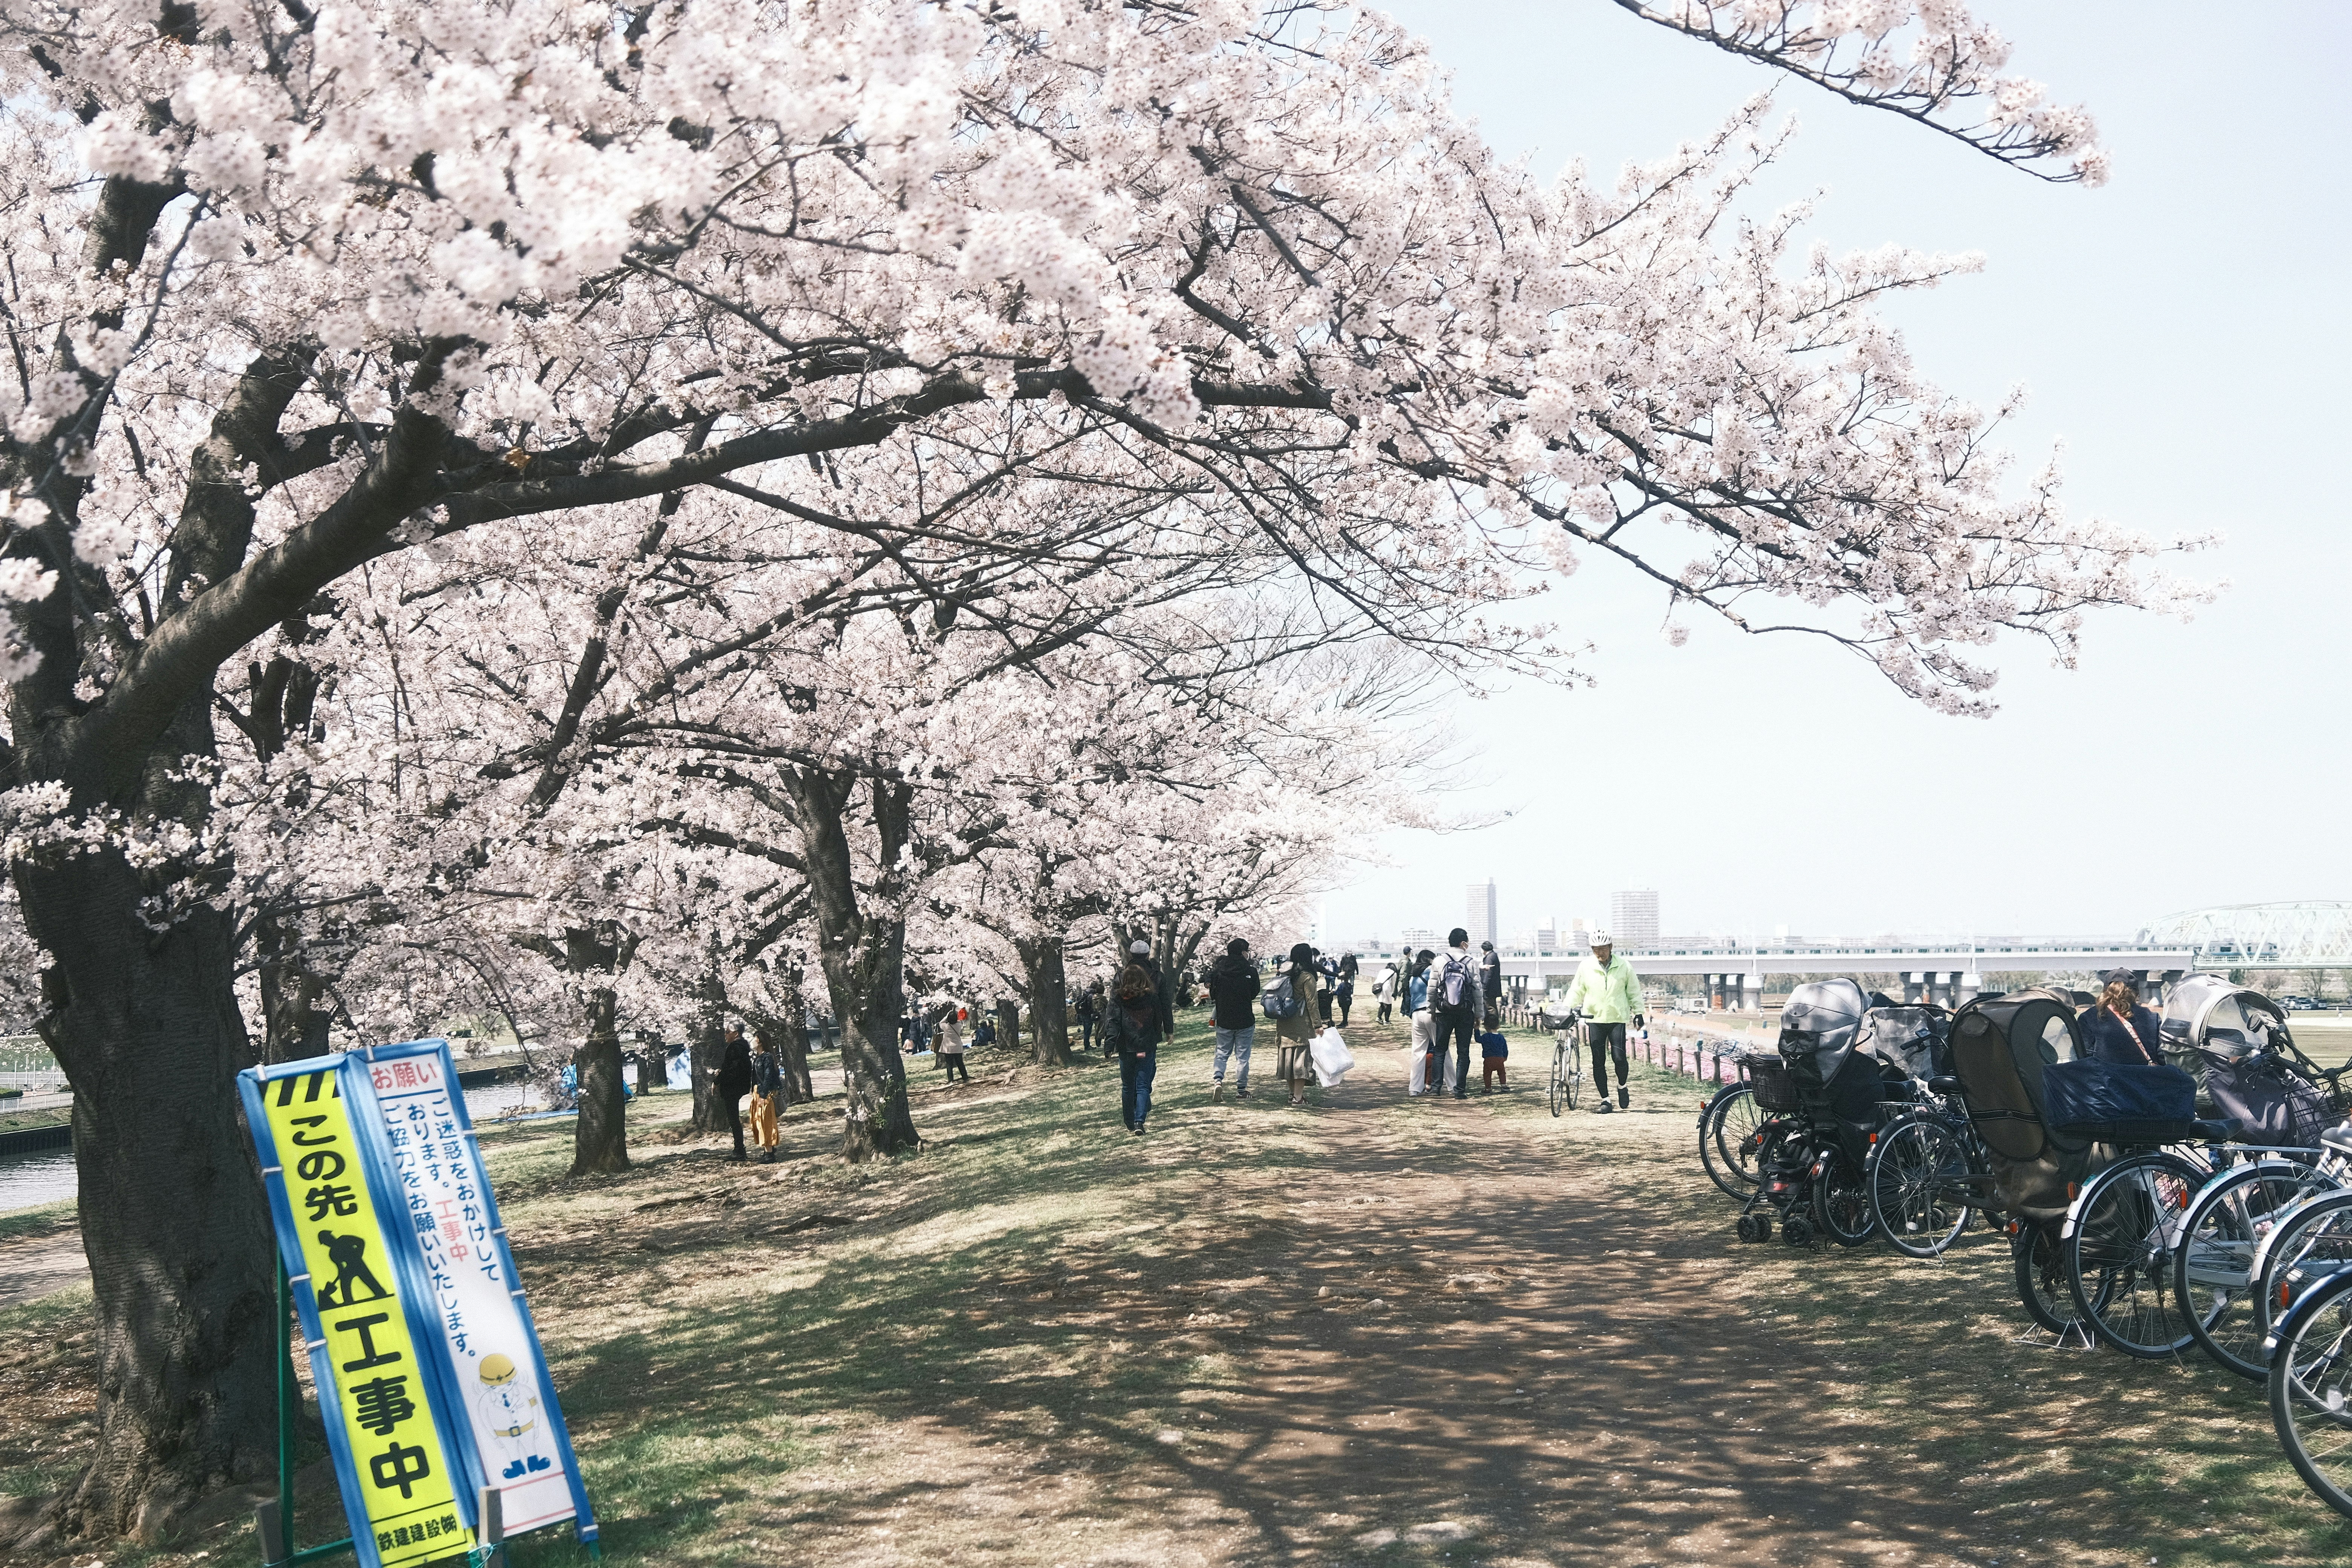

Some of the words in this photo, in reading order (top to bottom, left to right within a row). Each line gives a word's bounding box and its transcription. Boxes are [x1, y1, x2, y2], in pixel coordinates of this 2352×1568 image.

[372, 1062, 437, 1089] お願い
[385, 1104, 475, 1357] ご協力をお願いいたします。
[432, 1097, 499, 1281] ご迷惑をおかけして
